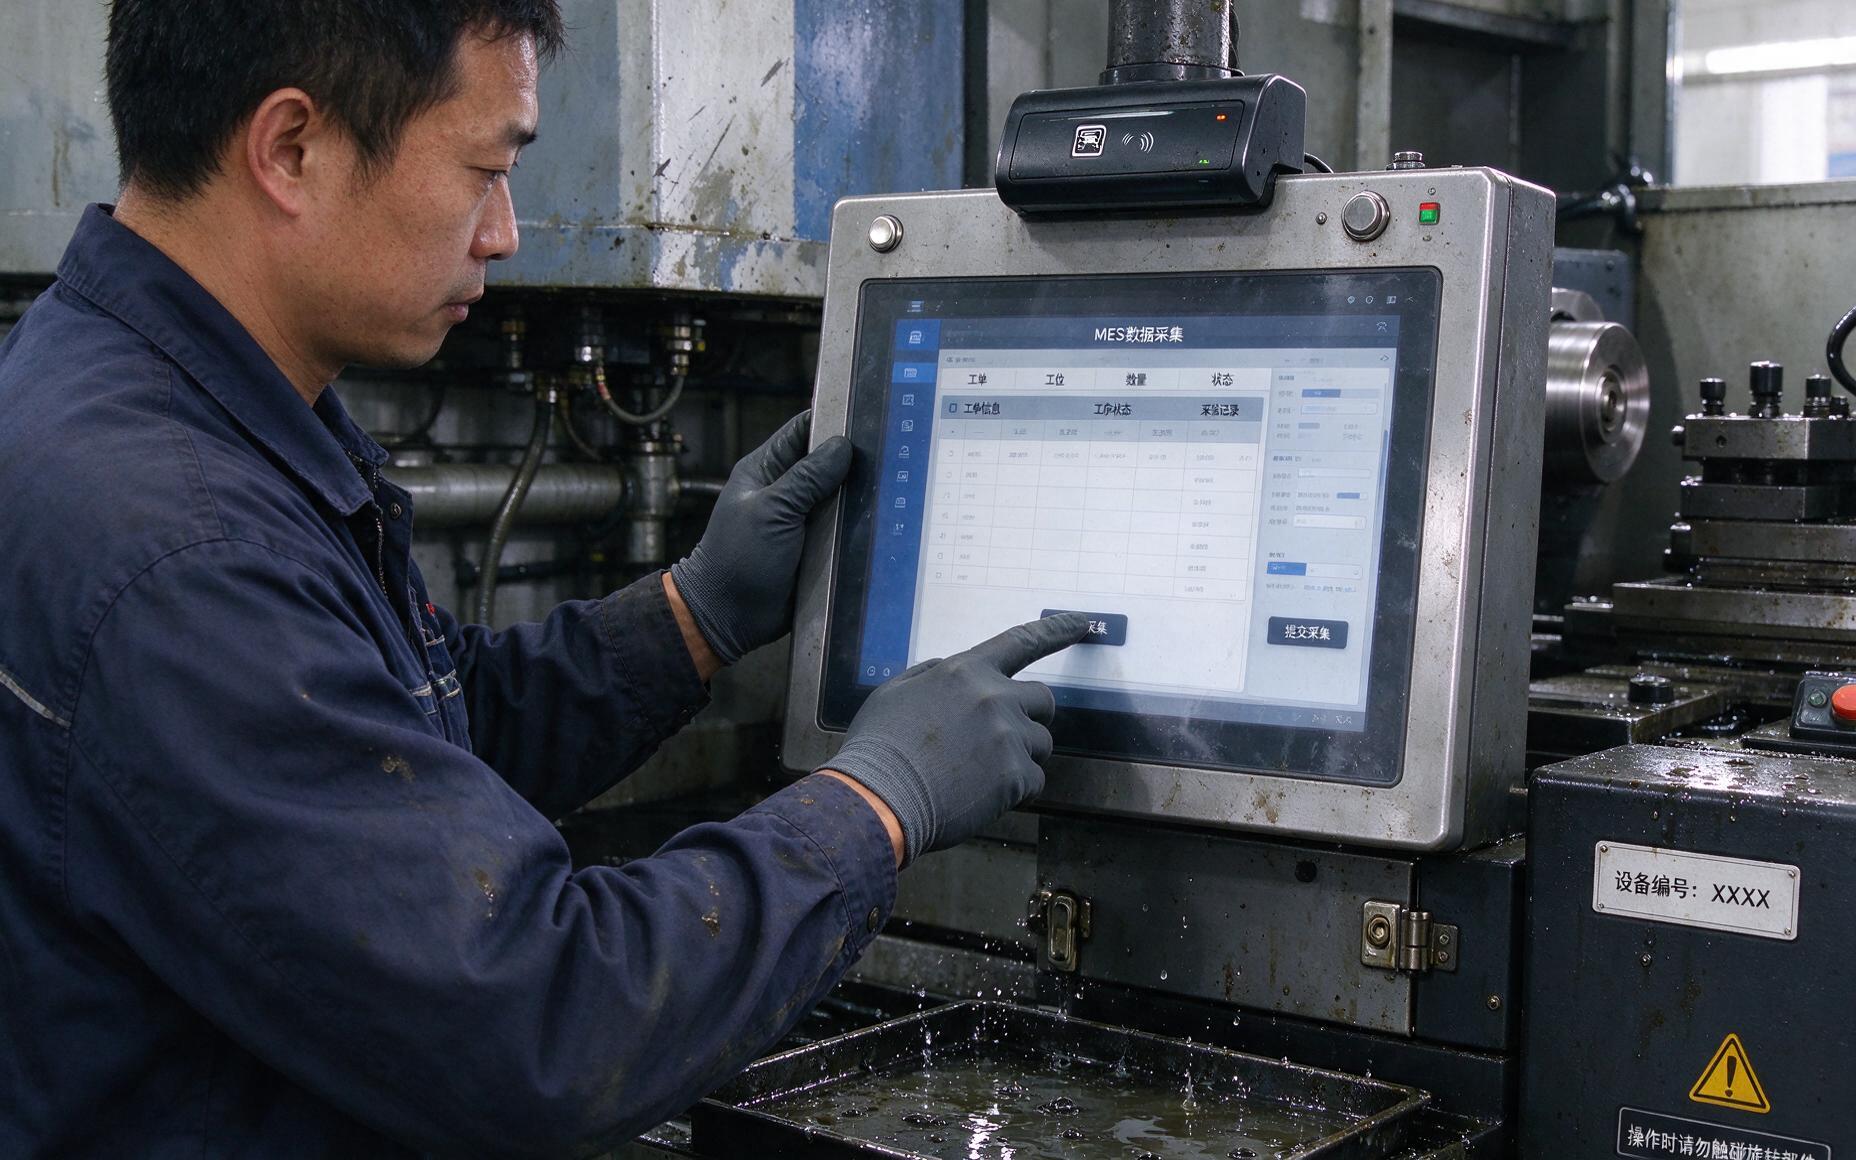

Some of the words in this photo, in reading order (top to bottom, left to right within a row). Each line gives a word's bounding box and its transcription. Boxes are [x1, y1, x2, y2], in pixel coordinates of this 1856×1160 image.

[1094, 326, 1184, 343] MES数据采集
[967, 373, 988, 387] 工单
[1045, 373, 1065, 387] 工位
[1125, 373, 1147, 387] 数量
[1211, 372, 1235, 387] 状态
[1284, 624, 1331, 641] 提交采集
[1614, 870, 1698, 900] 设备编号：
[1711, 883, 1771, 910] XXXX
